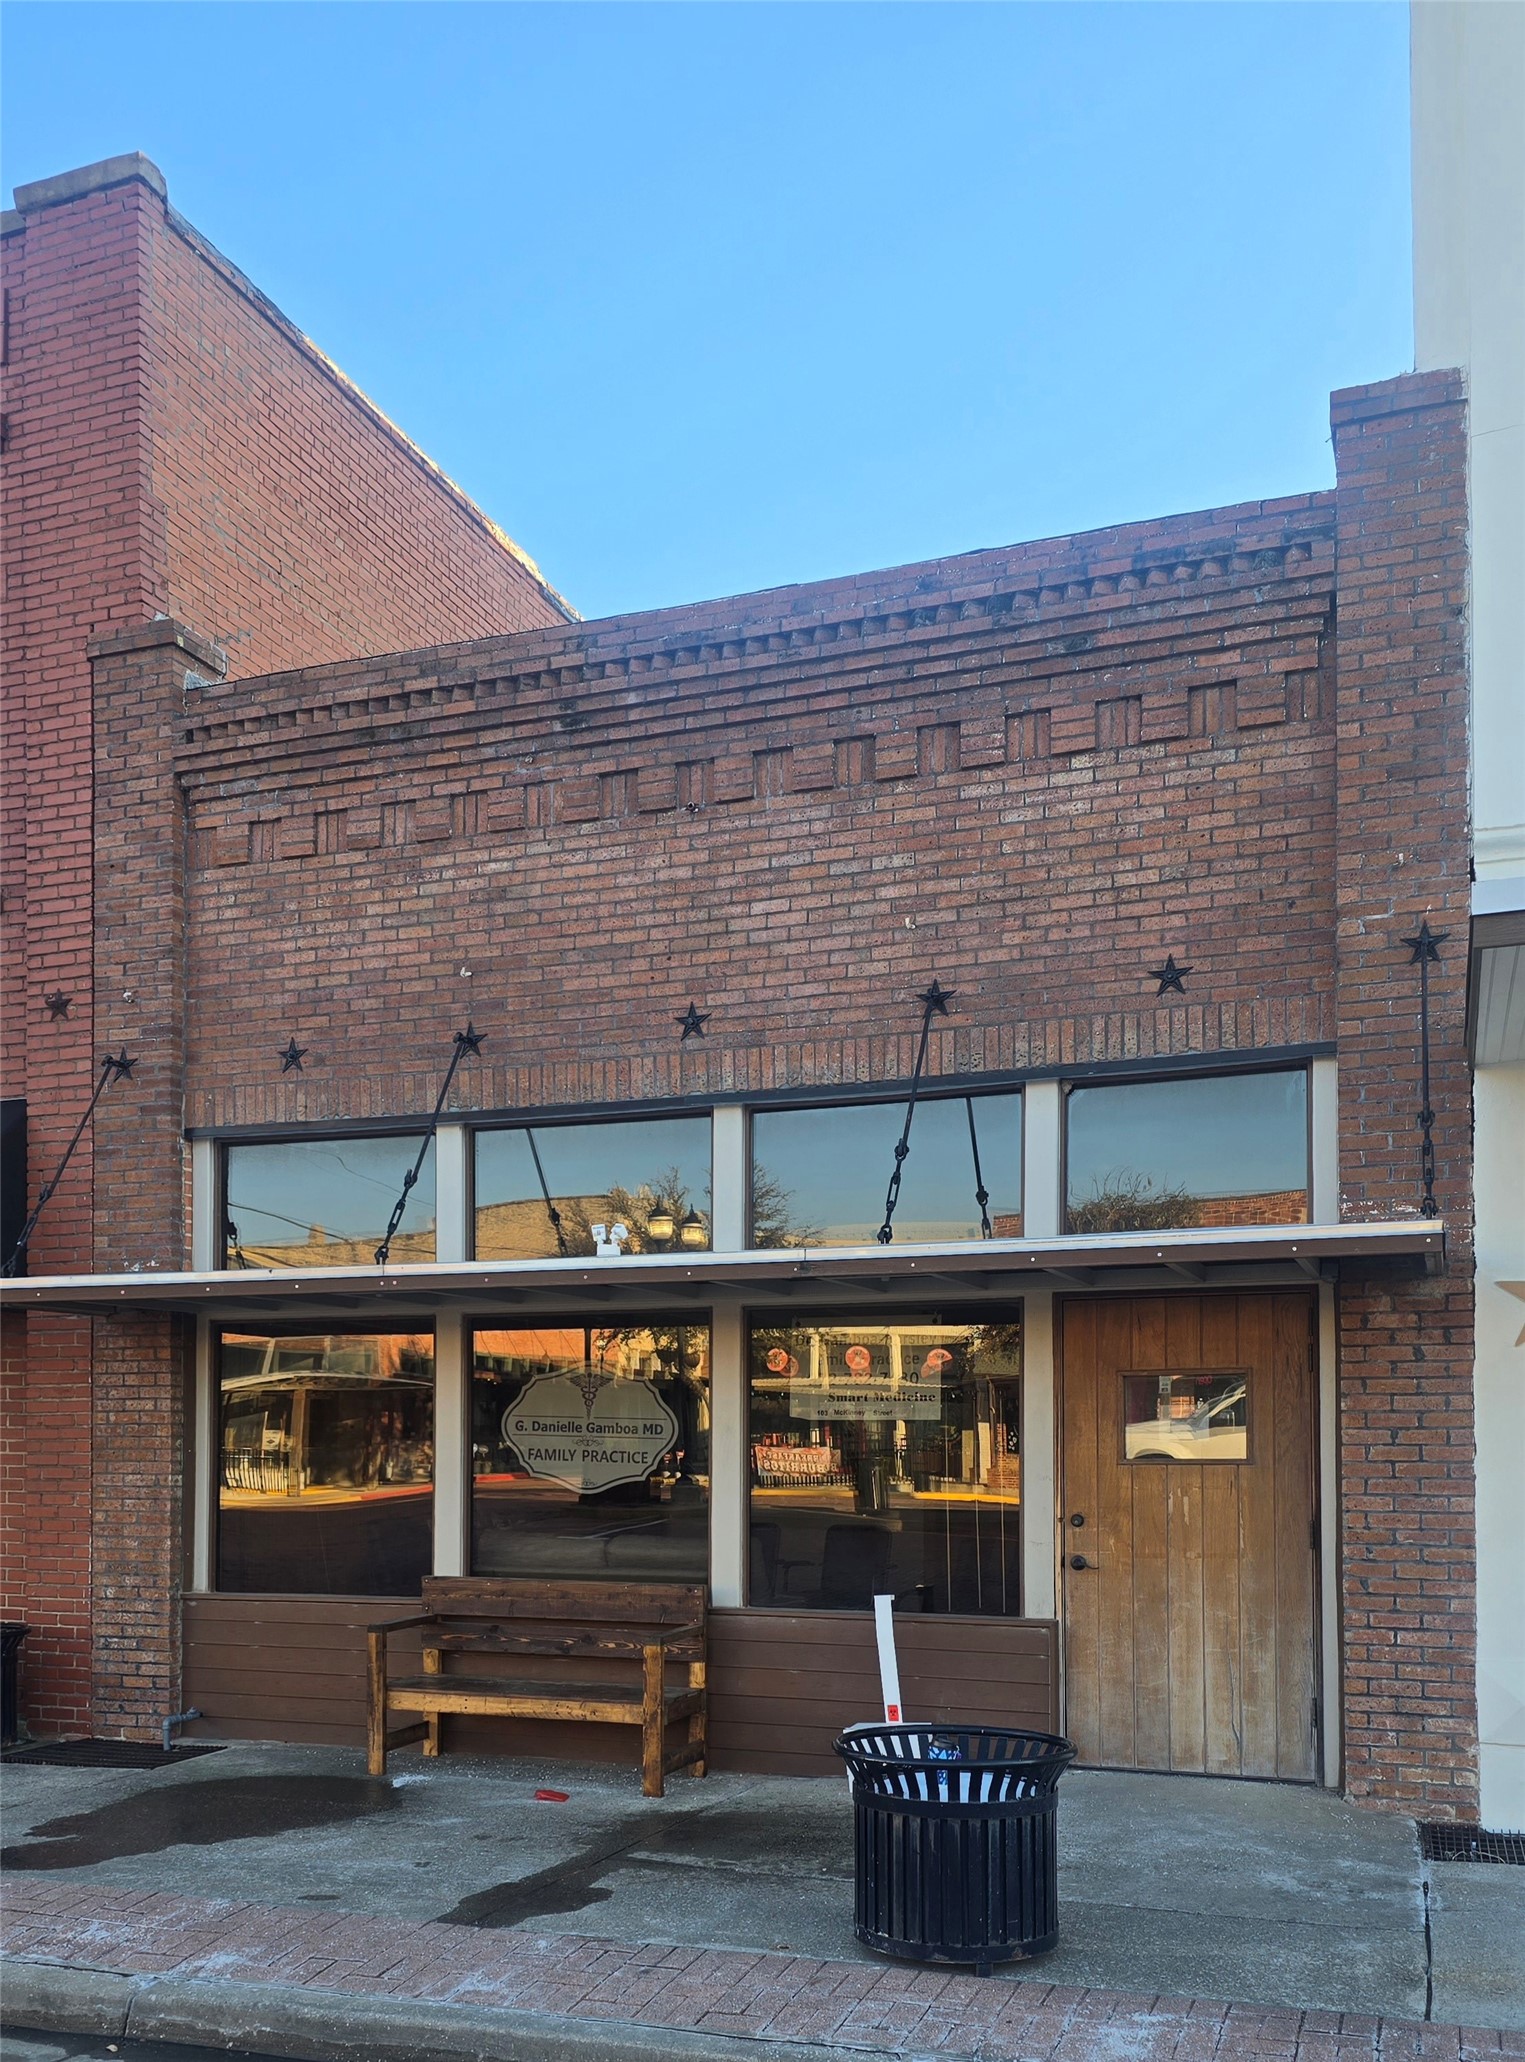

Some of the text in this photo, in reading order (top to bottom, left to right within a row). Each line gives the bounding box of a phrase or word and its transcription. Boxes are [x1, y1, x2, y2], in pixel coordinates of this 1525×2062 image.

[827, 1391, 937, 1403] Smart Medicine
[833, 1409, 866, 1418] McKinney
[873, 1409, 894, 1417] Street
[515, 1420, 664, 1436] G. Danielle Gamboa MD
[527, 1448, 649, 1464] FAMILY PRACTICE
